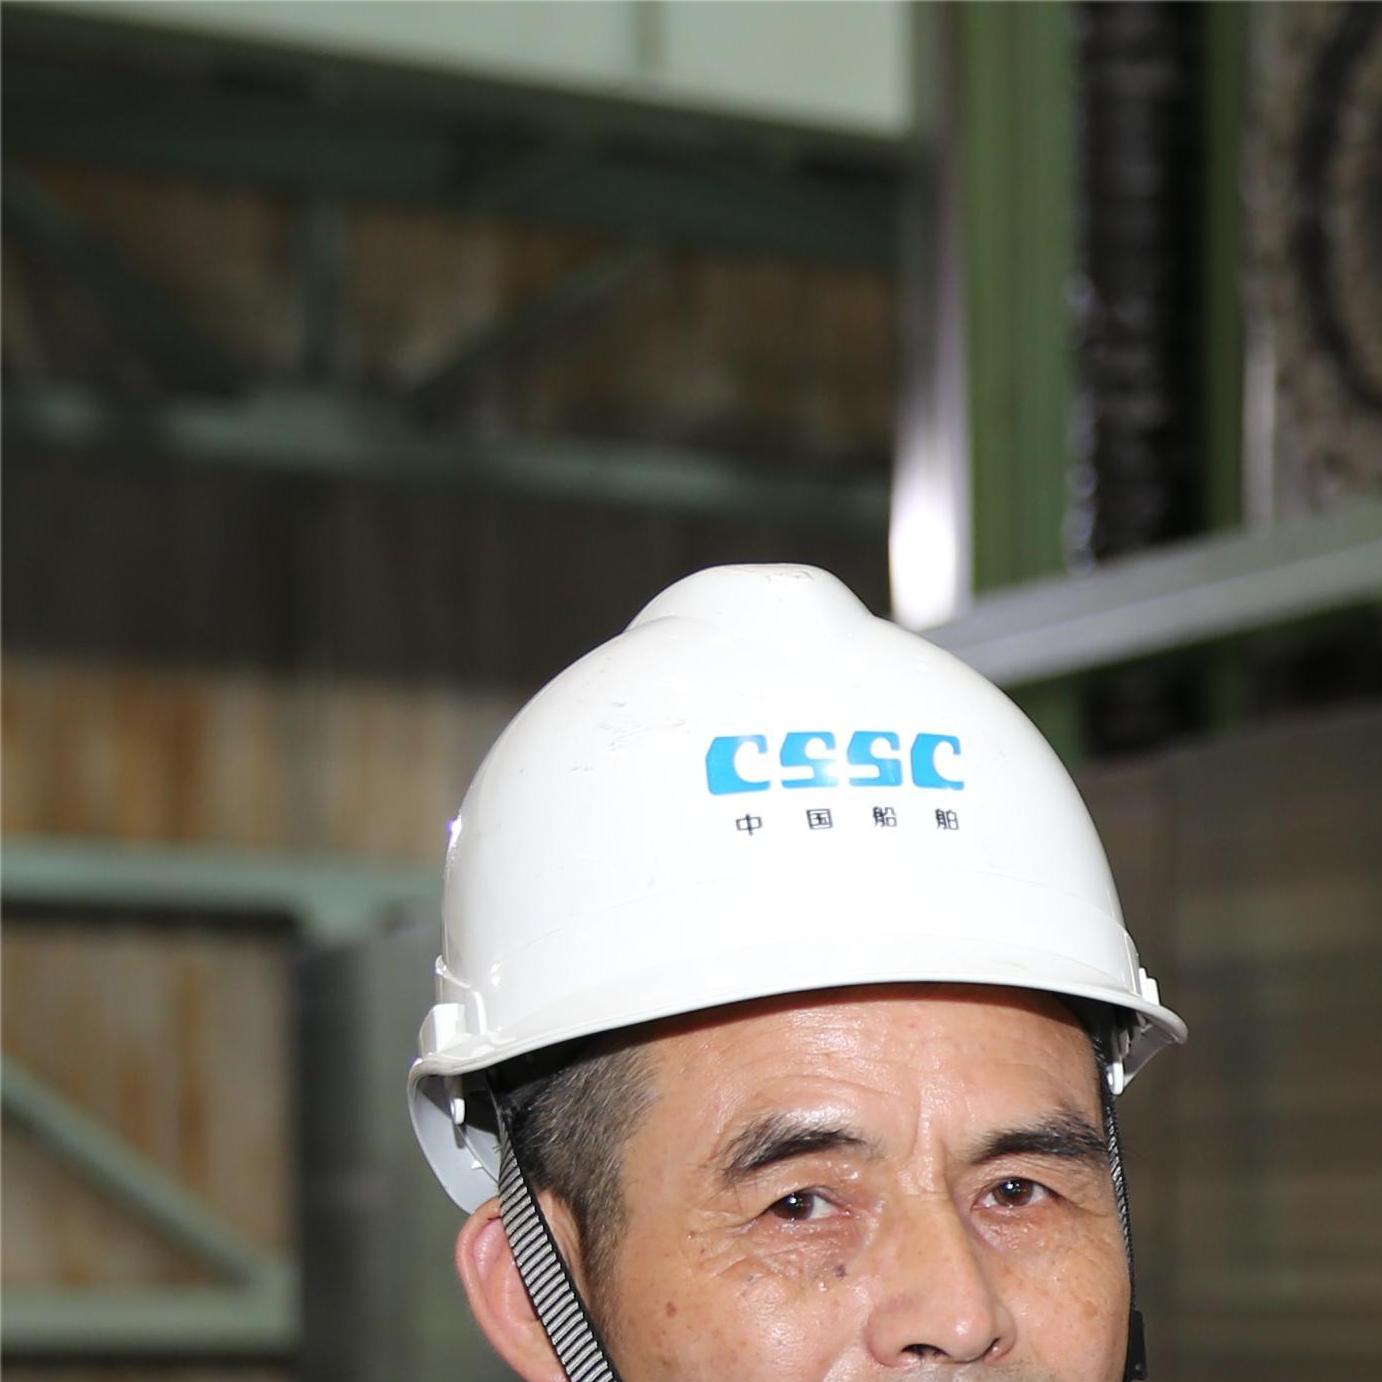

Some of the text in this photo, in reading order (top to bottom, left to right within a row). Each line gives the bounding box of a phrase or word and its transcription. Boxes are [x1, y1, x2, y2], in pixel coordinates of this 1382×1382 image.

[705, 731, 964, 795] CSSC
[735, 806, 960, 835] 中国船舶
